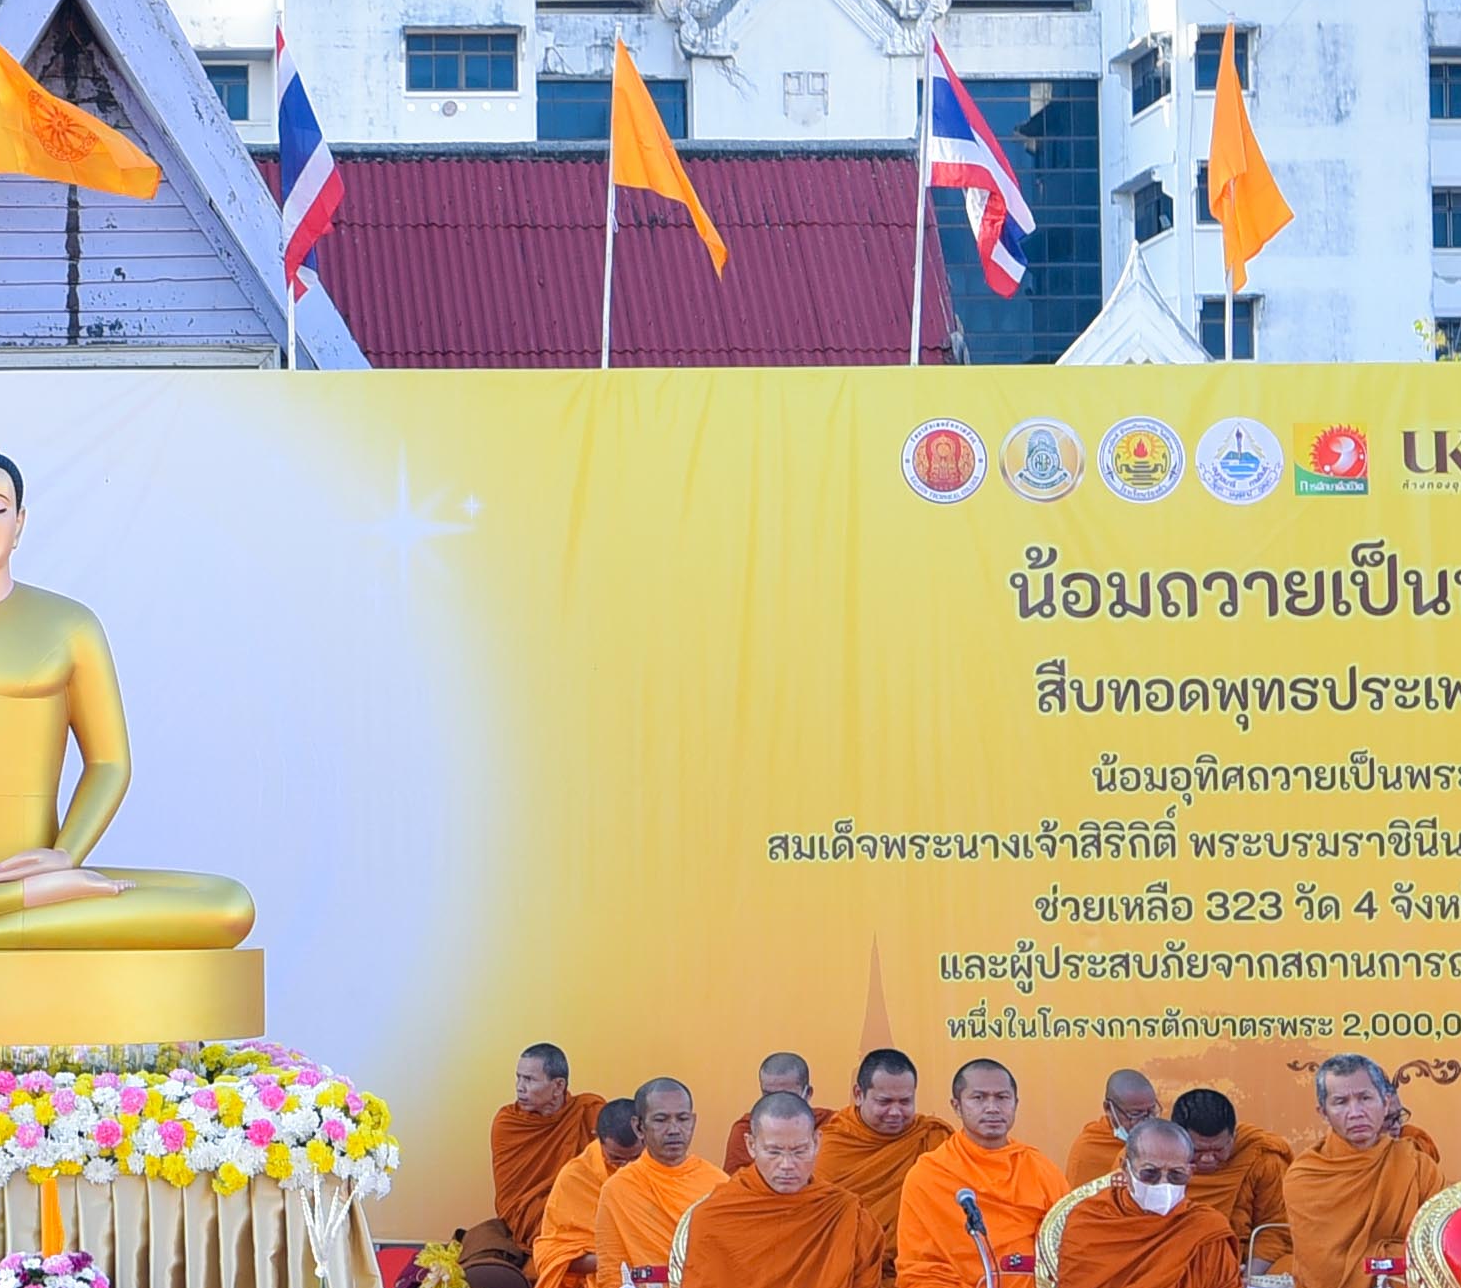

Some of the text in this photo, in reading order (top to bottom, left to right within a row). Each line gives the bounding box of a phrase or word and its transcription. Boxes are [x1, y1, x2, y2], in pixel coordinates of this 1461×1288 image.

[768, 804, 1177, 861] สมเด็จพระนางเจ้าสิริกิติ์
[1035, 881, 1193, 922] ช่วยเหลือ
[1206, 891, 1283, 921] 323
[1295, 883, 1340, 921] วัด
[1353, 890, 1378, 920] 4
[947, 1007, 1333, 1038] หนึ่งในโครงการตักบาตรพระ
